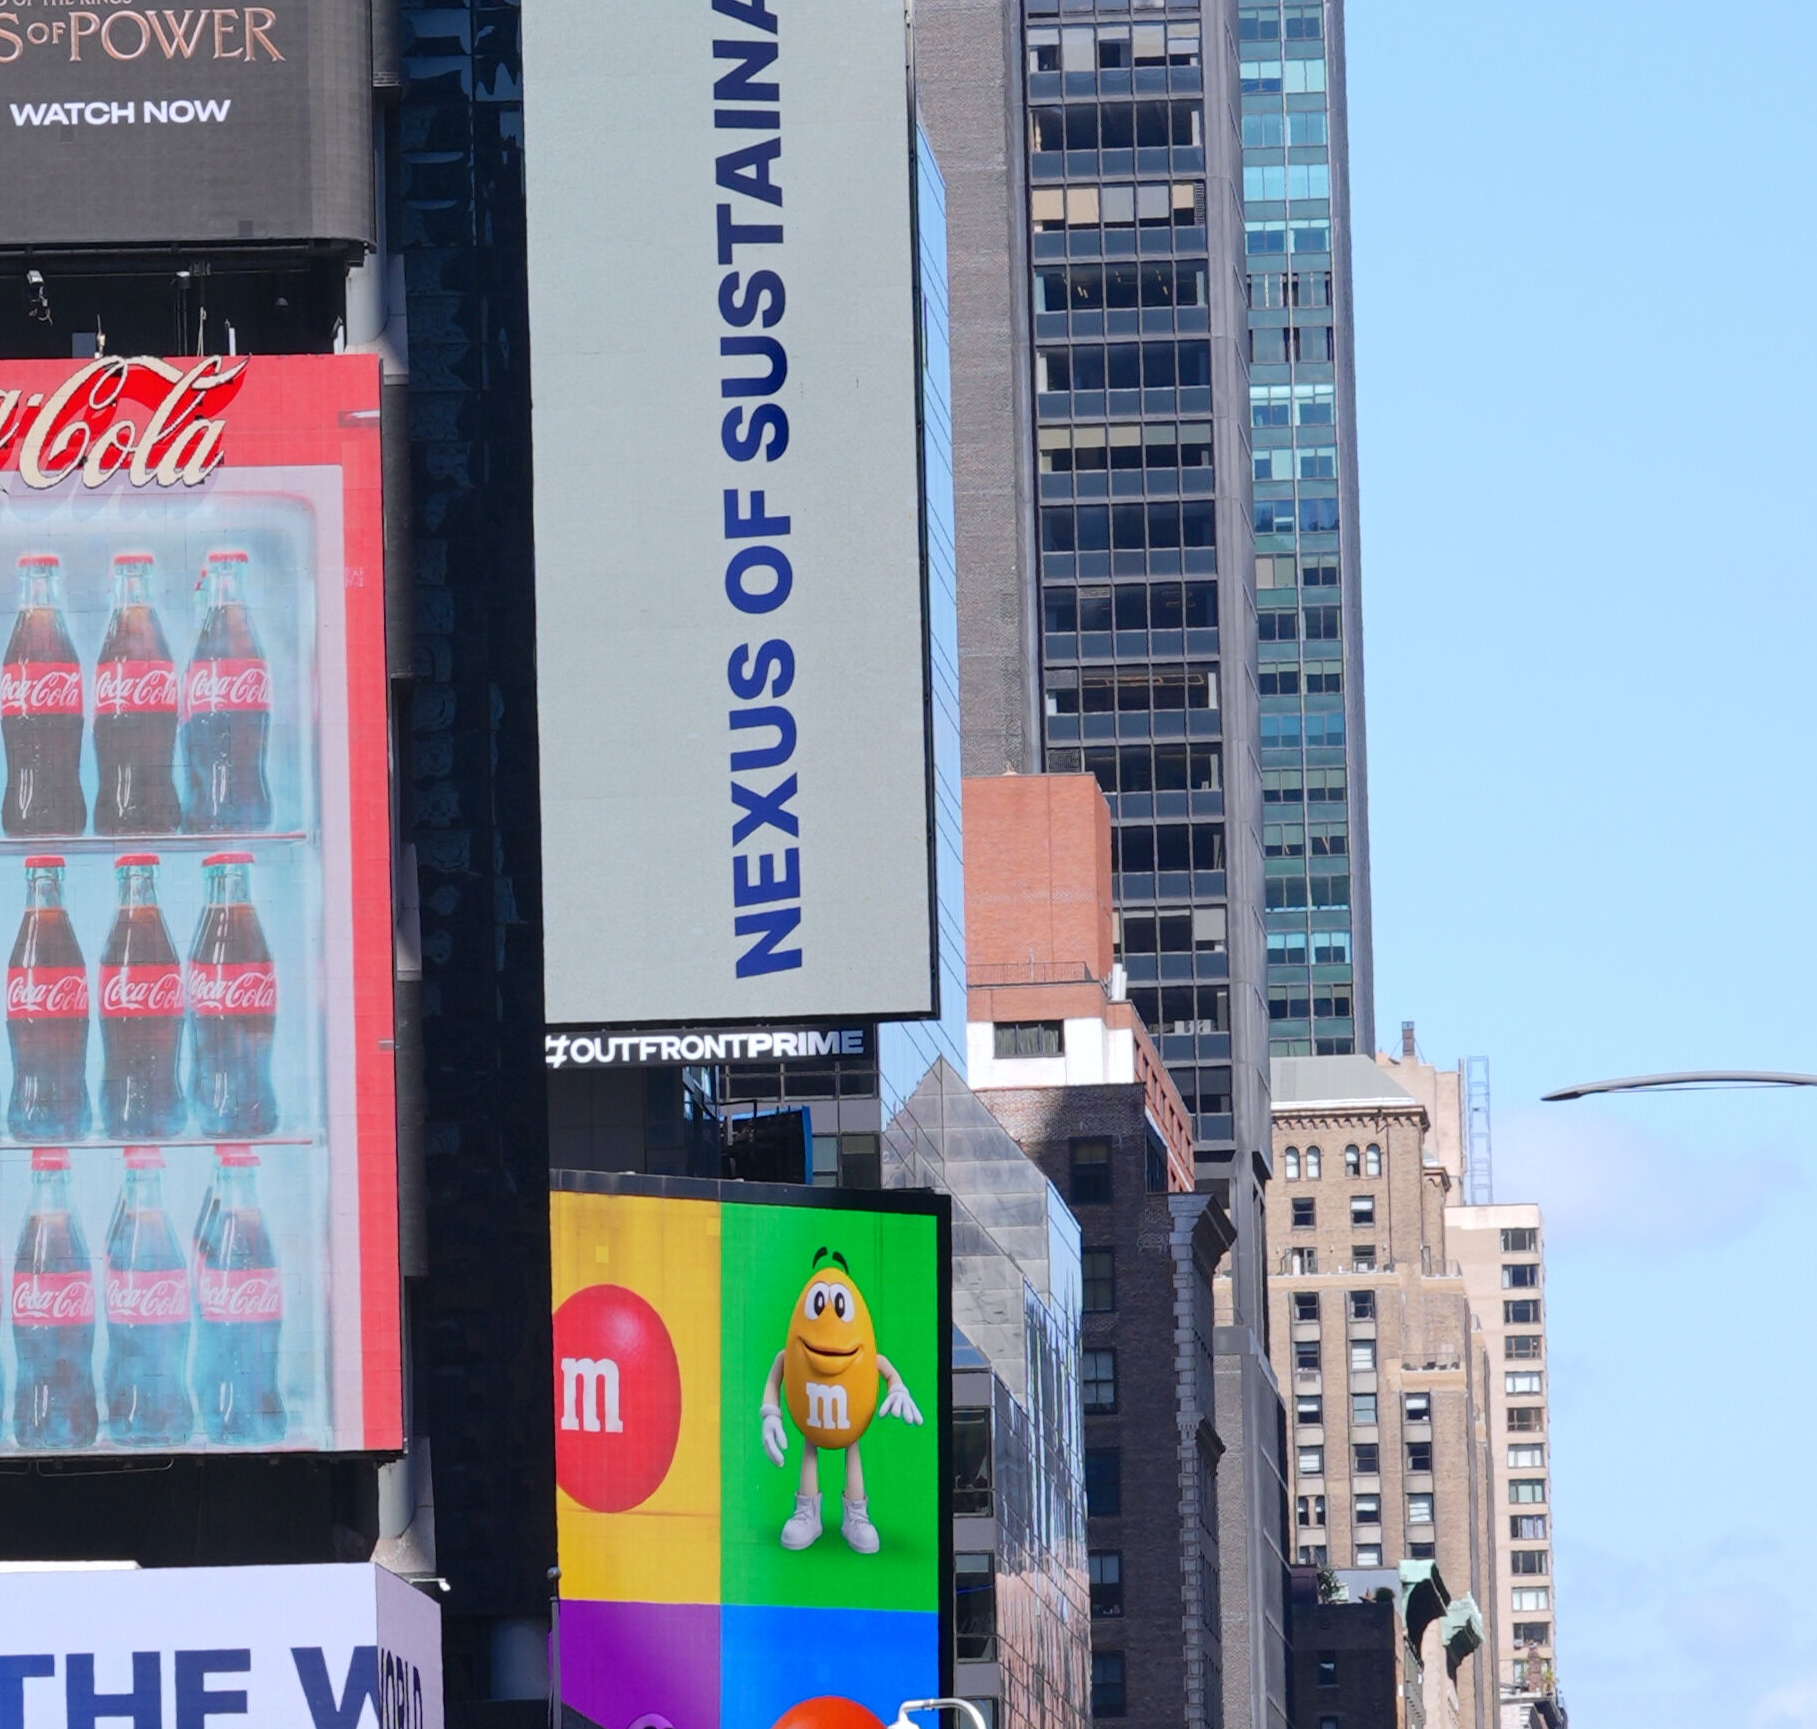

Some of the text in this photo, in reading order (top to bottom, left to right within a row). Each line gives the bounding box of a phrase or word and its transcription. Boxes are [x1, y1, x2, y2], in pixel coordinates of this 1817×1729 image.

[26, 20, 66, 45] OF
[67, 7, 286, 66] POWER
[10, 100, 136, 126] WATCH
[142, 97, 231, 123] NOW
[723, 488, 795, 617] OF
[726, 640, 802, 980] NEXUS
[561, 1357, 624, 1433] m
[806, 1382, 851, 1430] m
